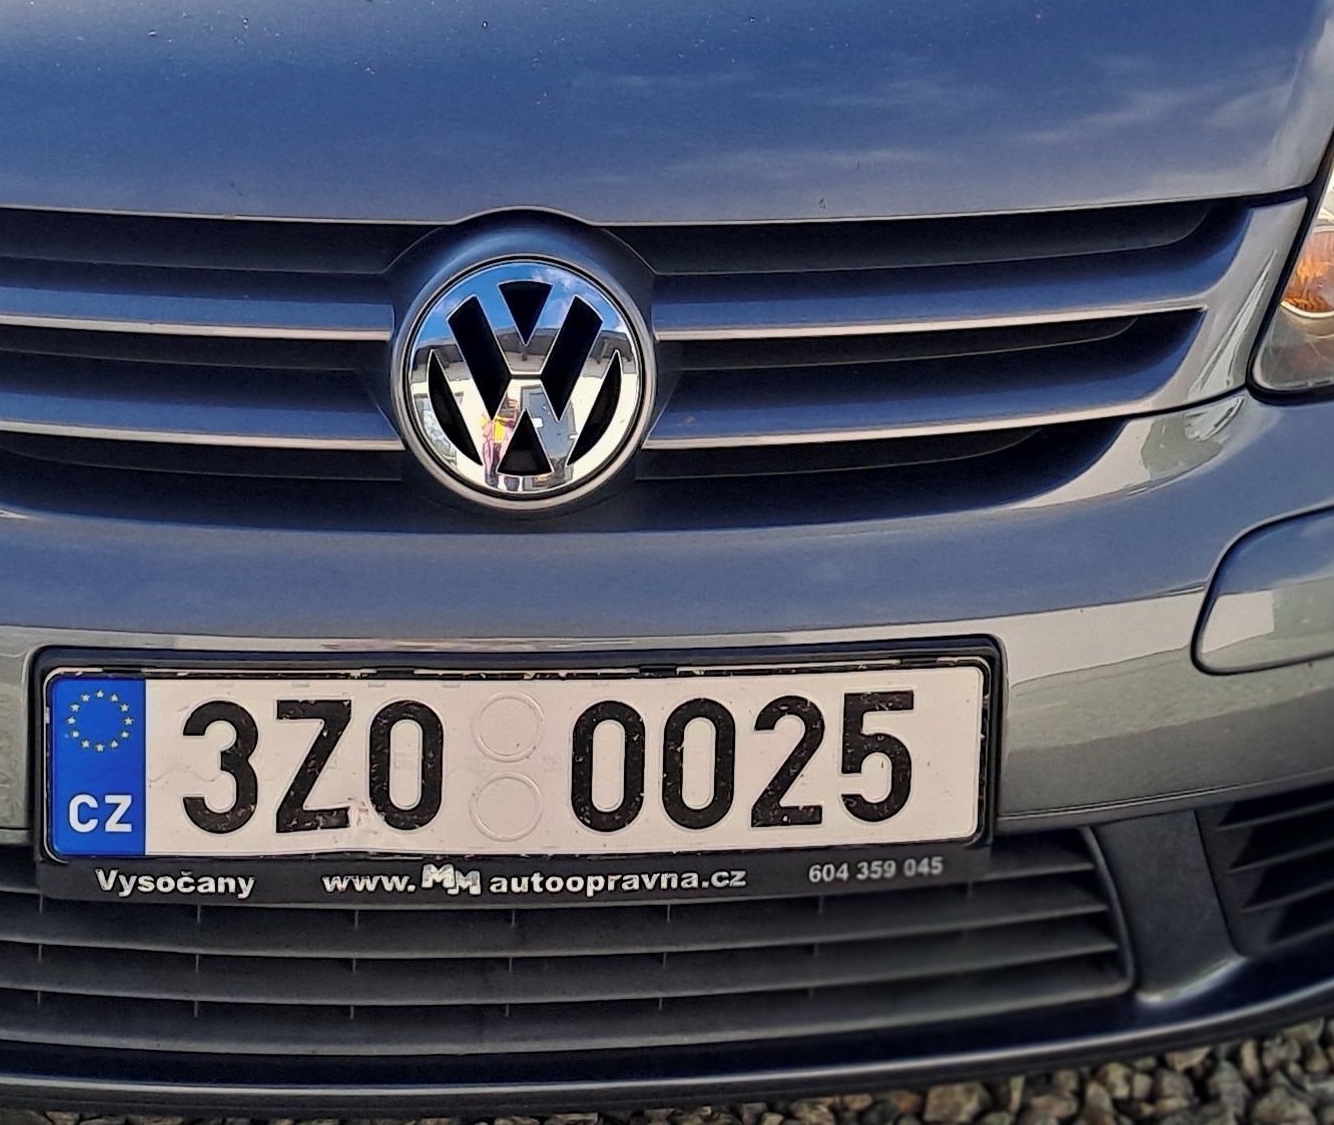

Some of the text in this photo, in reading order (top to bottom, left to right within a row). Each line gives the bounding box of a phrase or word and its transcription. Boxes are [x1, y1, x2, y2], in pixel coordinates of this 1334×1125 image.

[182, 690, 915, 835] 3Z0 0025
[68, 793, 134, 833] CZ
[94, 868, 256, 899] Vysočany
[808, 856, 944, 883] 604 359 045
